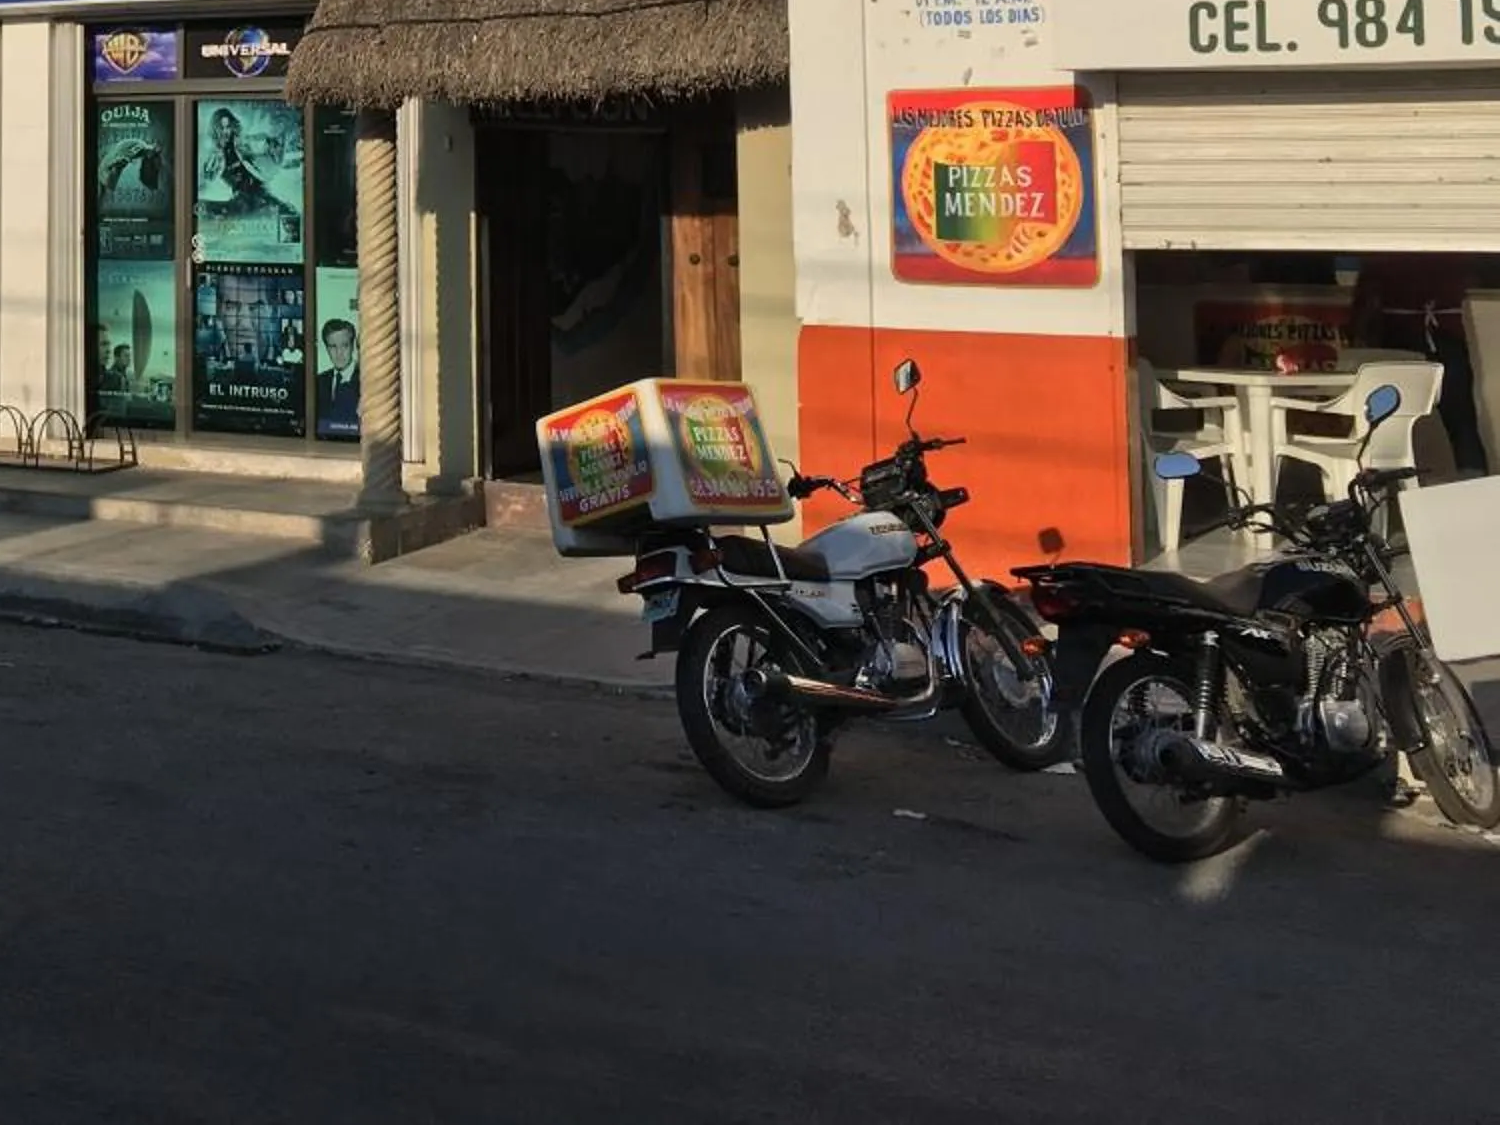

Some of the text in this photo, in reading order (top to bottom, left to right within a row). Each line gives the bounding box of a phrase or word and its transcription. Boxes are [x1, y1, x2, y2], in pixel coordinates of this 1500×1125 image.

[979, 8, 1003, 25] LOS
[200, 41, 292, 58] UNIVERSAL
[100, 104, 151, 124] OUIJA
[980, 108, 1034, 129] PIZZAS
[947, 165, 1033, 189] PIZZAS
[944, 191, 1046, 218] MENDEZ
[208, 383, 290, 401] EL INTRUSO
[579, 483, 631, 513] GRATIS
